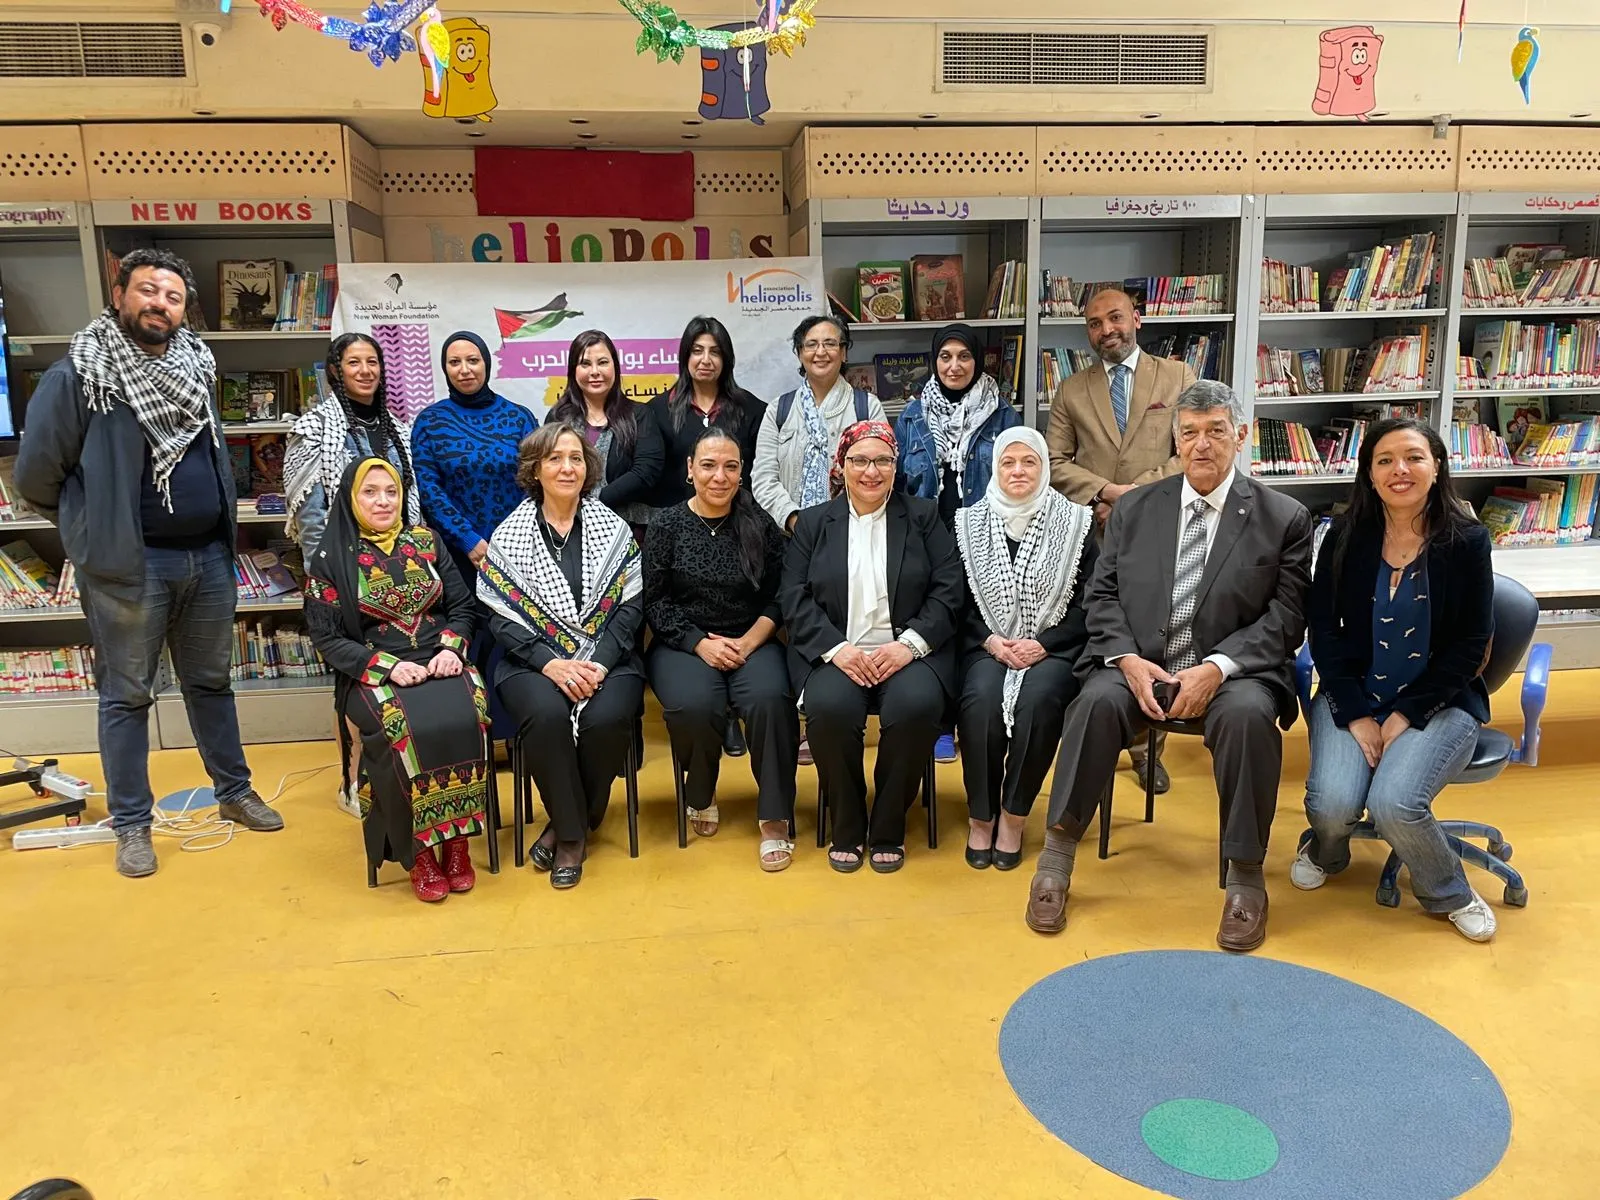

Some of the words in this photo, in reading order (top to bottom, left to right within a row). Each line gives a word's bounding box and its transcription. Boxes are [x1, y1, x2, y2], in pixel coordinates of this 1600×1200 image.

[887, 198, 934, 220] حديثا
[937, 200, 969, 219] ورد
[1150, 199, 1179, 216] تاريخ
[1525, 196, 1567, 210] وحكايات
[1567, 194, 1600, 210] قصص
[0, 208, 65, 224] eography
[131, 203, 197, 221] NEW
[218, 203, 312, 221] BOOKS
[426, 221, 775, 263] heliopolis
[228, 270, 272, 280] Dinosaurs
[740, 277, 812, 305] heliopolis
[354, 301, 384, 312] الجديدة
[385, 301, 407, 313] المرأة
[408, 301, 437, 312] مؤسسة
[399, 312, 440, 320] Foundation
[521, 350, 570, 372] الحرب
[637, 347, 680, 365] ساء
